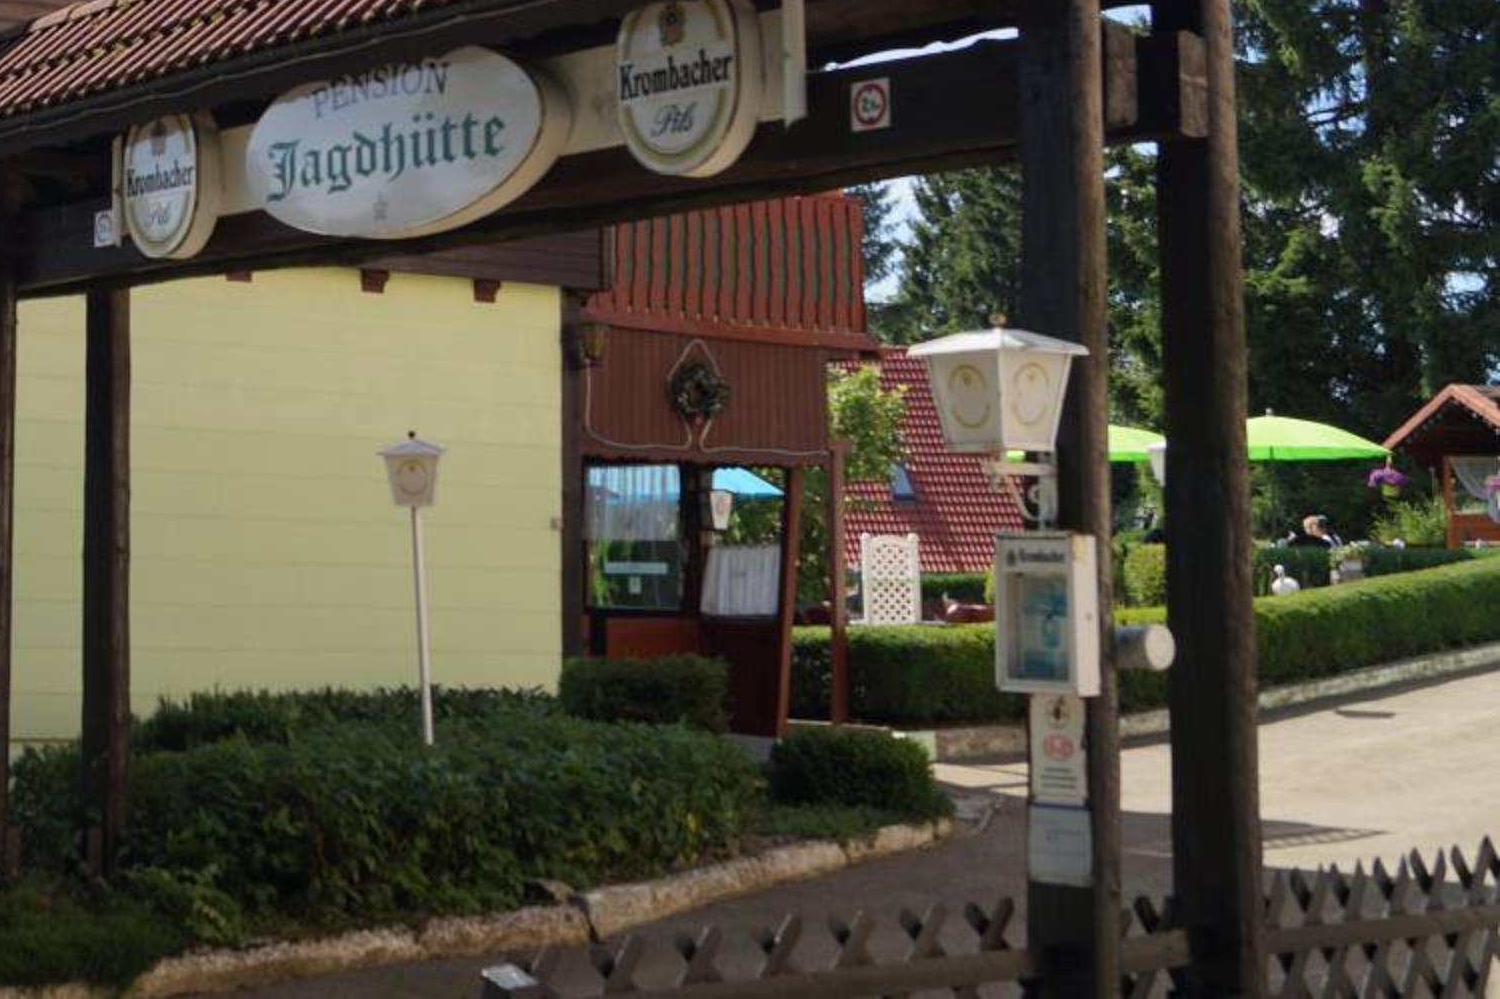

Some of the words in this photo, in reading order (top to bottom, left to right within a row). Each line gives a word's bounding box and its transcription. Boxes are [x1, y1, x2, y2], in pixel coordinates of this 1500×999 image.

[309, 61, 451, 120] PENSION
[619, 48, 734, 101] Krombacher
[651, 100, 696, 138] Pils
[126, 159, 195, 199] Krombacher
[267, 111, 505, 202] Jagdhütte
